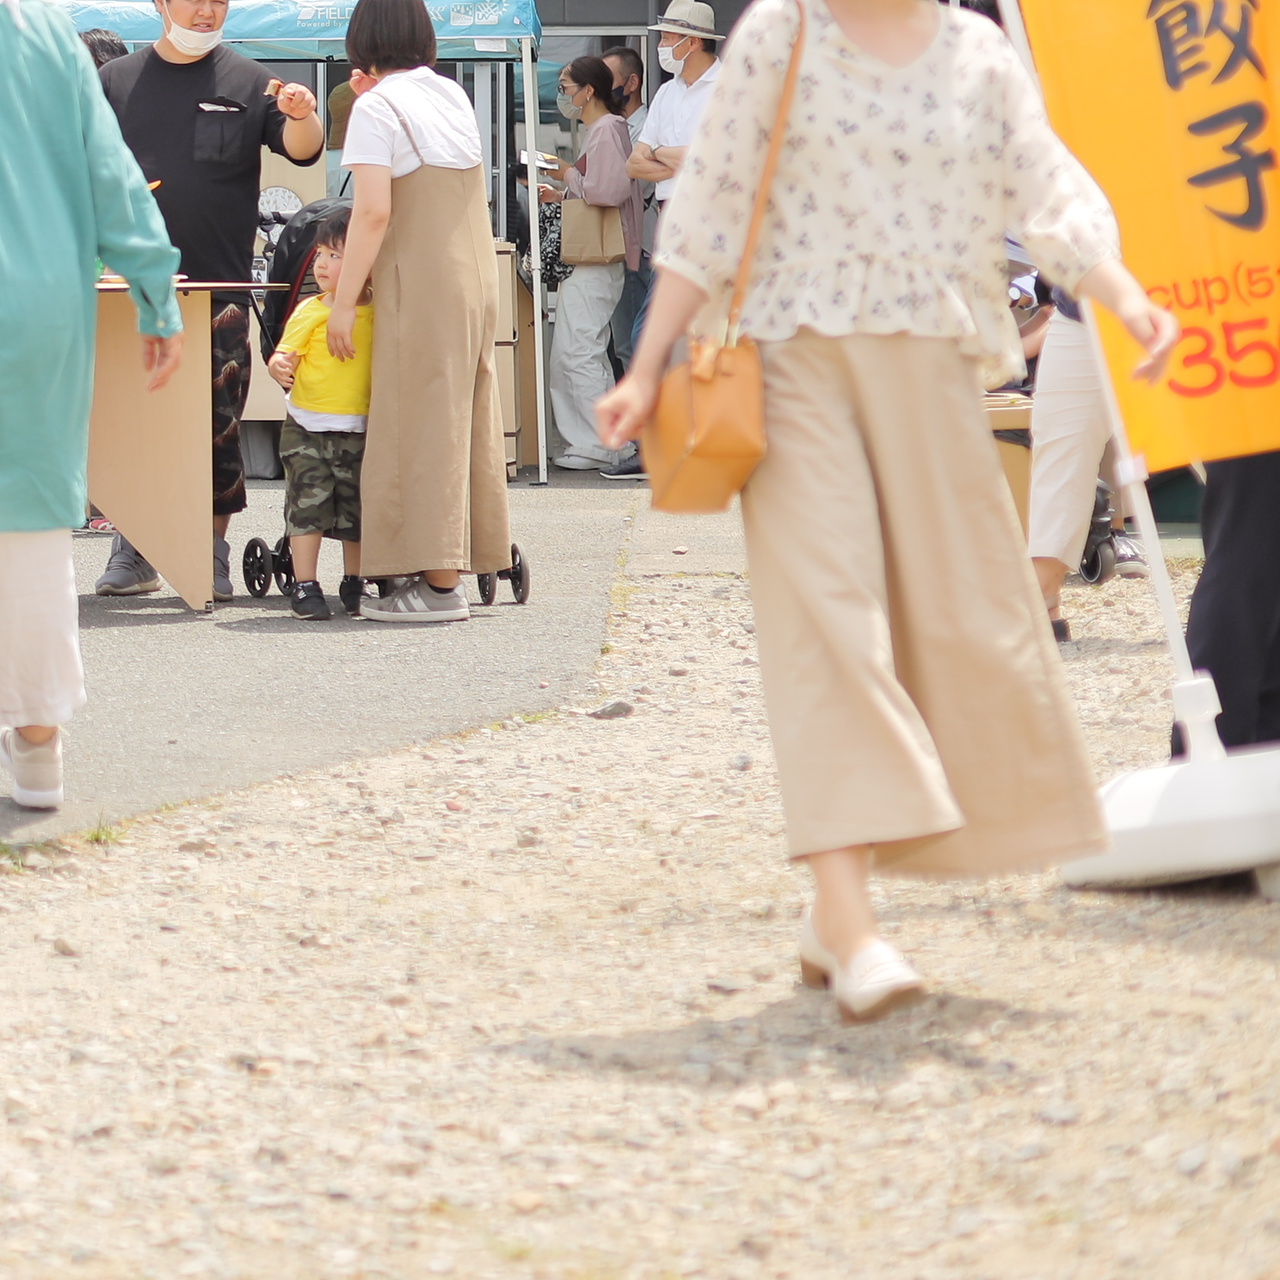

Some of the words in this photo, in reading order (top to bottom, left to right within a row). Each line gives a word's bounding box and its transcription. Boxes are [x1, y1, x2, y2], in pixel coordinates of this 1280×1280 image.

[296, 20, 331, 28] Powered
[333, 20, 343, 28] by
[1146, 261, 1280, 316] cup(5
[1168, 316, 1280, 398] 35
